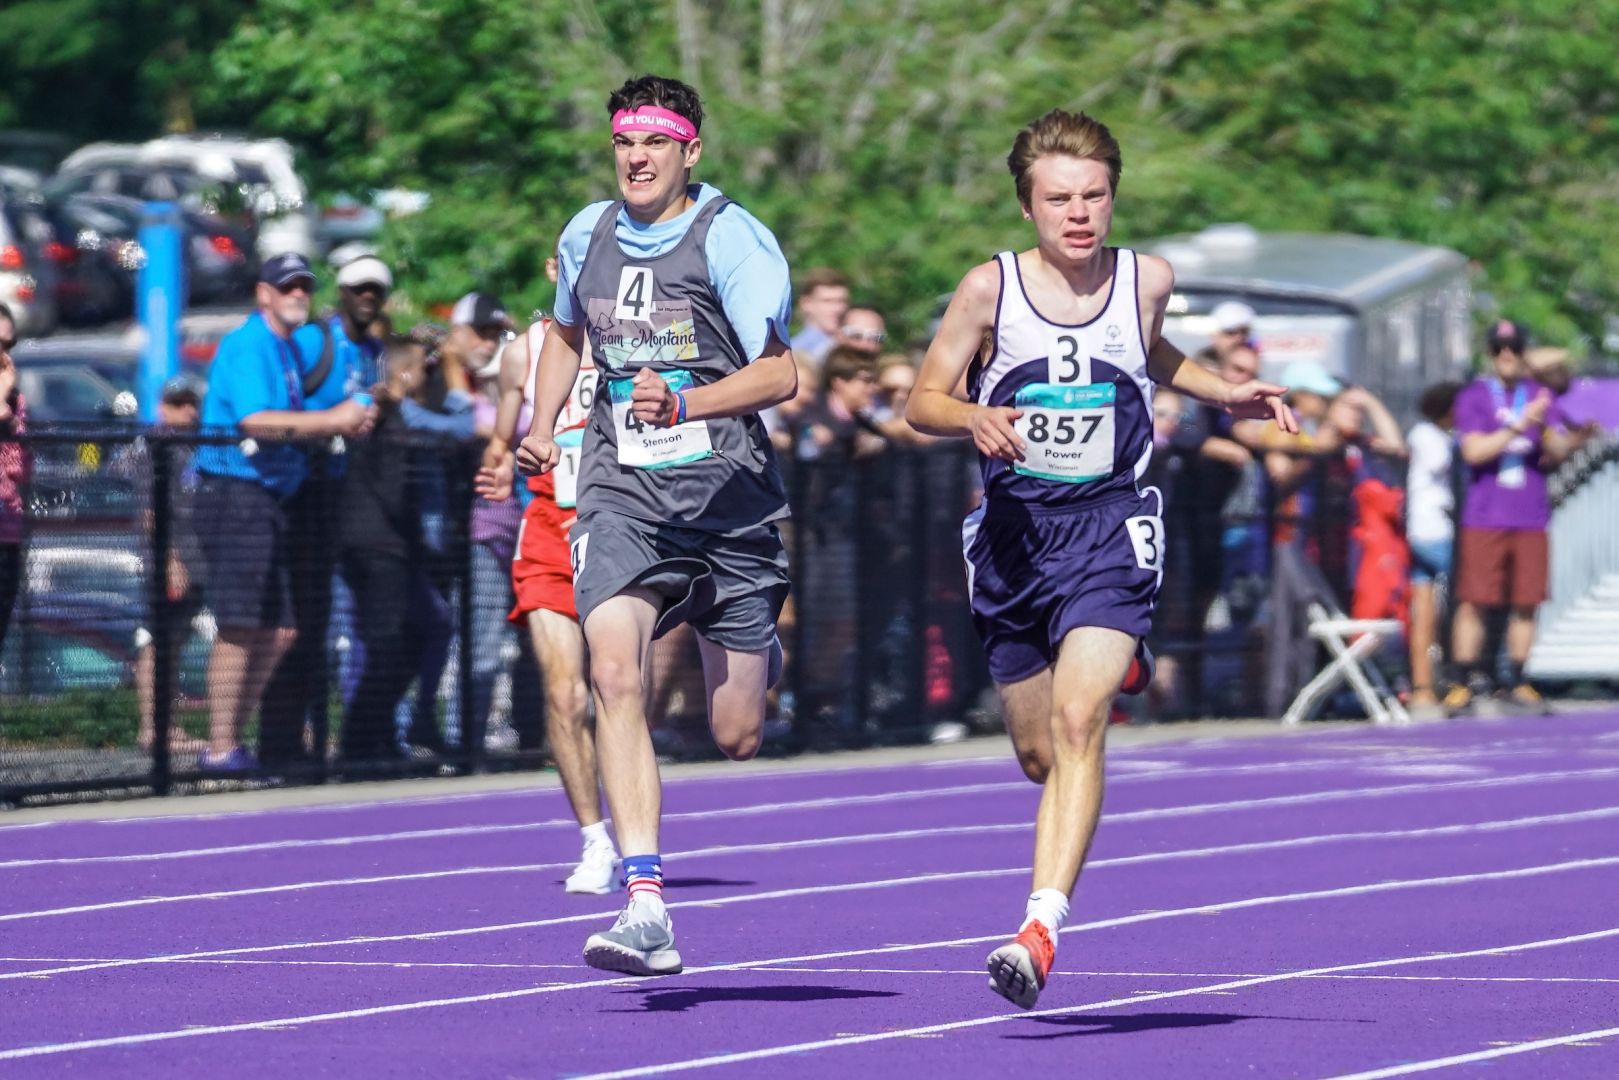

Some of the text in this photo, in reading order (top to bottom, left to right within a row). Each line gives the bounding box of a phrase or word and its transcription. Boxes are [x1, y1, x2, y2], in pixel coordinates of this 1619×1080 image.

[620, 115, 634, 125] ARE
[636, 114, 655, 124] YOU
[656, 117, 676, 130] WITH
[622, 271, 644, 317] 4
[631, 328, 696, 349] Montana
[1056, 335, 1080, 383] 3
[579, 375, 593, 410] 6
[642, 433, 682, 448] Stenson
[1027, 413, 1105, 444] 857
[1044, 448, 1083, 459] Power
[571, 541, 581, 577] 4
[1137, 519, 1158, 566] 3
